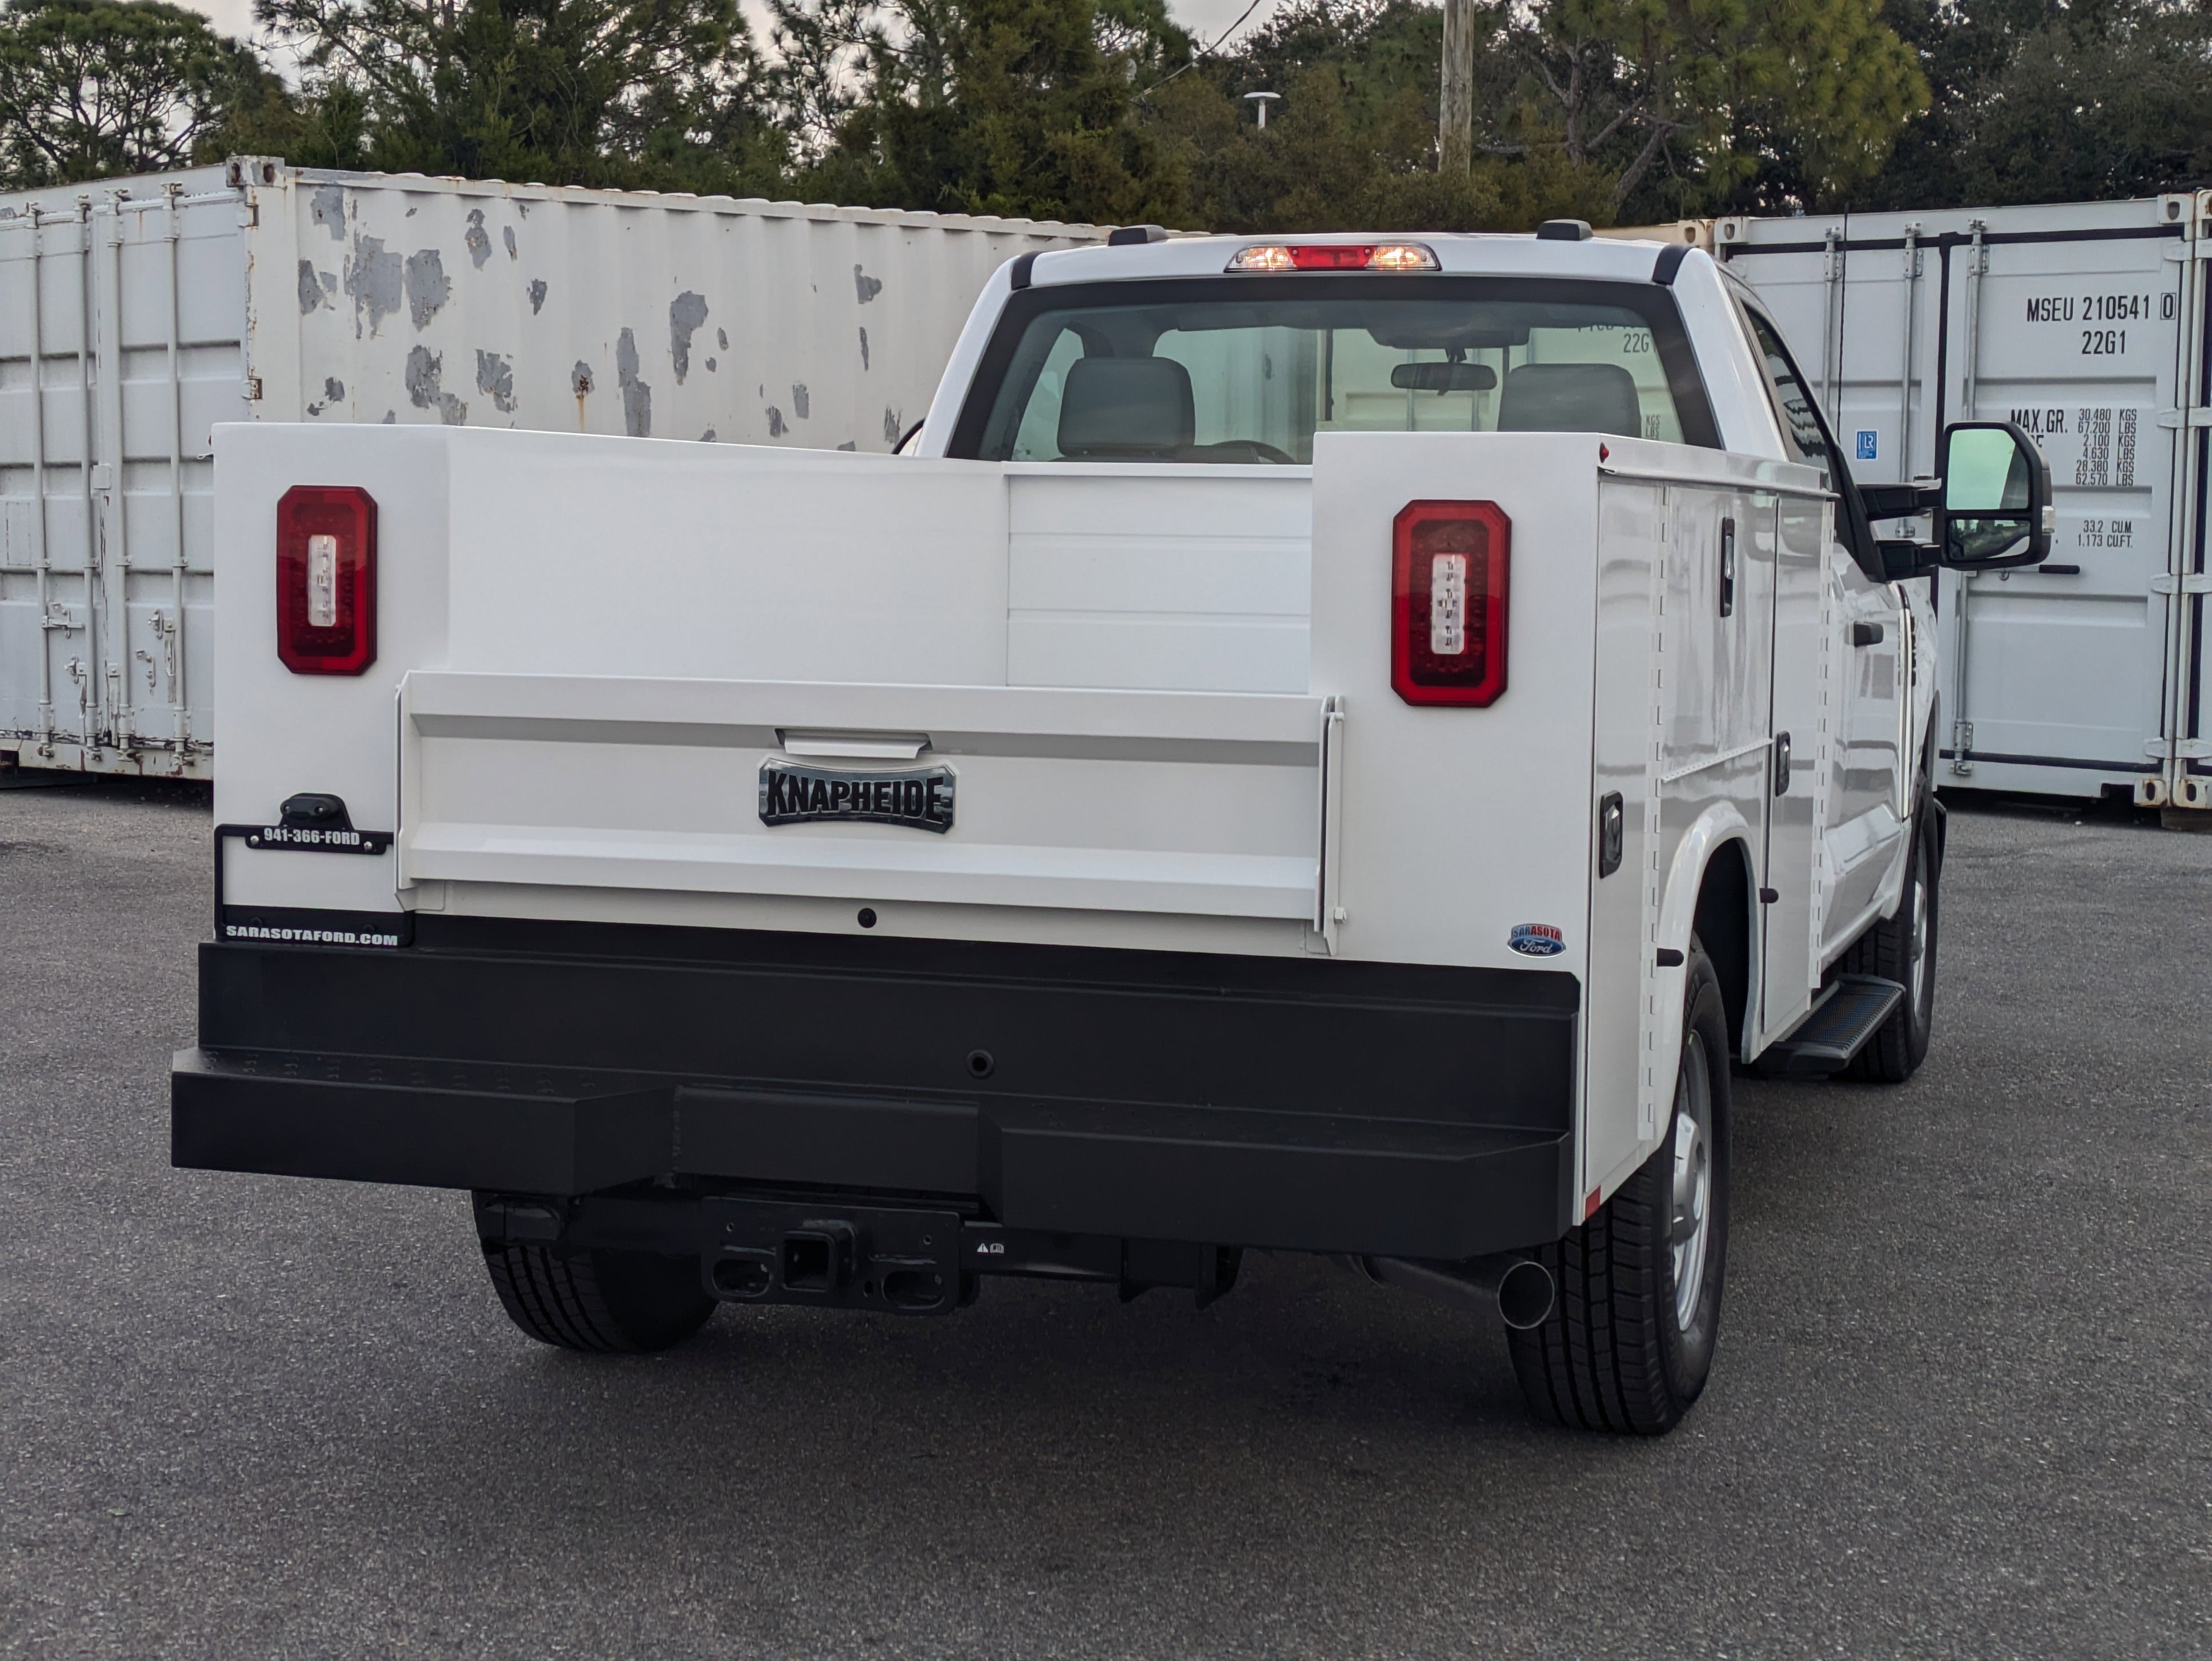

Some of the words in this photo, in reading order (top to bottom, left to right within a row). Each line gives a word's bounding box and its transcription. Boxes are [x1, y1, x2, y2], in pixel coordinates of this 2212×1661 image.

[2026, 297, 2074, 322] MSEU
[2082, 294, 2149, 321] 210541
[2162, 294, 2174, 319] 0
[2081, 330, 2126, 354] 22G1
[2079, 408, 2112, 421] 30.480
[2119, 409, 2137, 421] KGS
[2078, 421, 2111, 434] 67.200
[2118, 421, 2136, 434] LBS
[2083, 434, 2110, 447] 2.100
[2118, 434, 2136, 447] KGS
[2082, 447, 2109, 460] 4.630
[2117, 447, 2135, 460] LBS
[2076, 459, 2109, 473] 28.380
[2116, 460, 2135, 473] KGS
[2076, 473, 2108, 486] 62.570
[2116, 473, 2134, 486] LBS
[2083, 520, 2103, 533] 33.2
[2078, 533, 2103, 547] 1.173
[767, 770, 944, 823] KNAPHEIDE
[264, 828, 360, 846] 941-366-FORD
[226, 925, 398, 946] SARASOTAFORD.COM
[1513, 925, 1560, 941] SARASOTA
[1519, 938, 1553, 953] Ford
